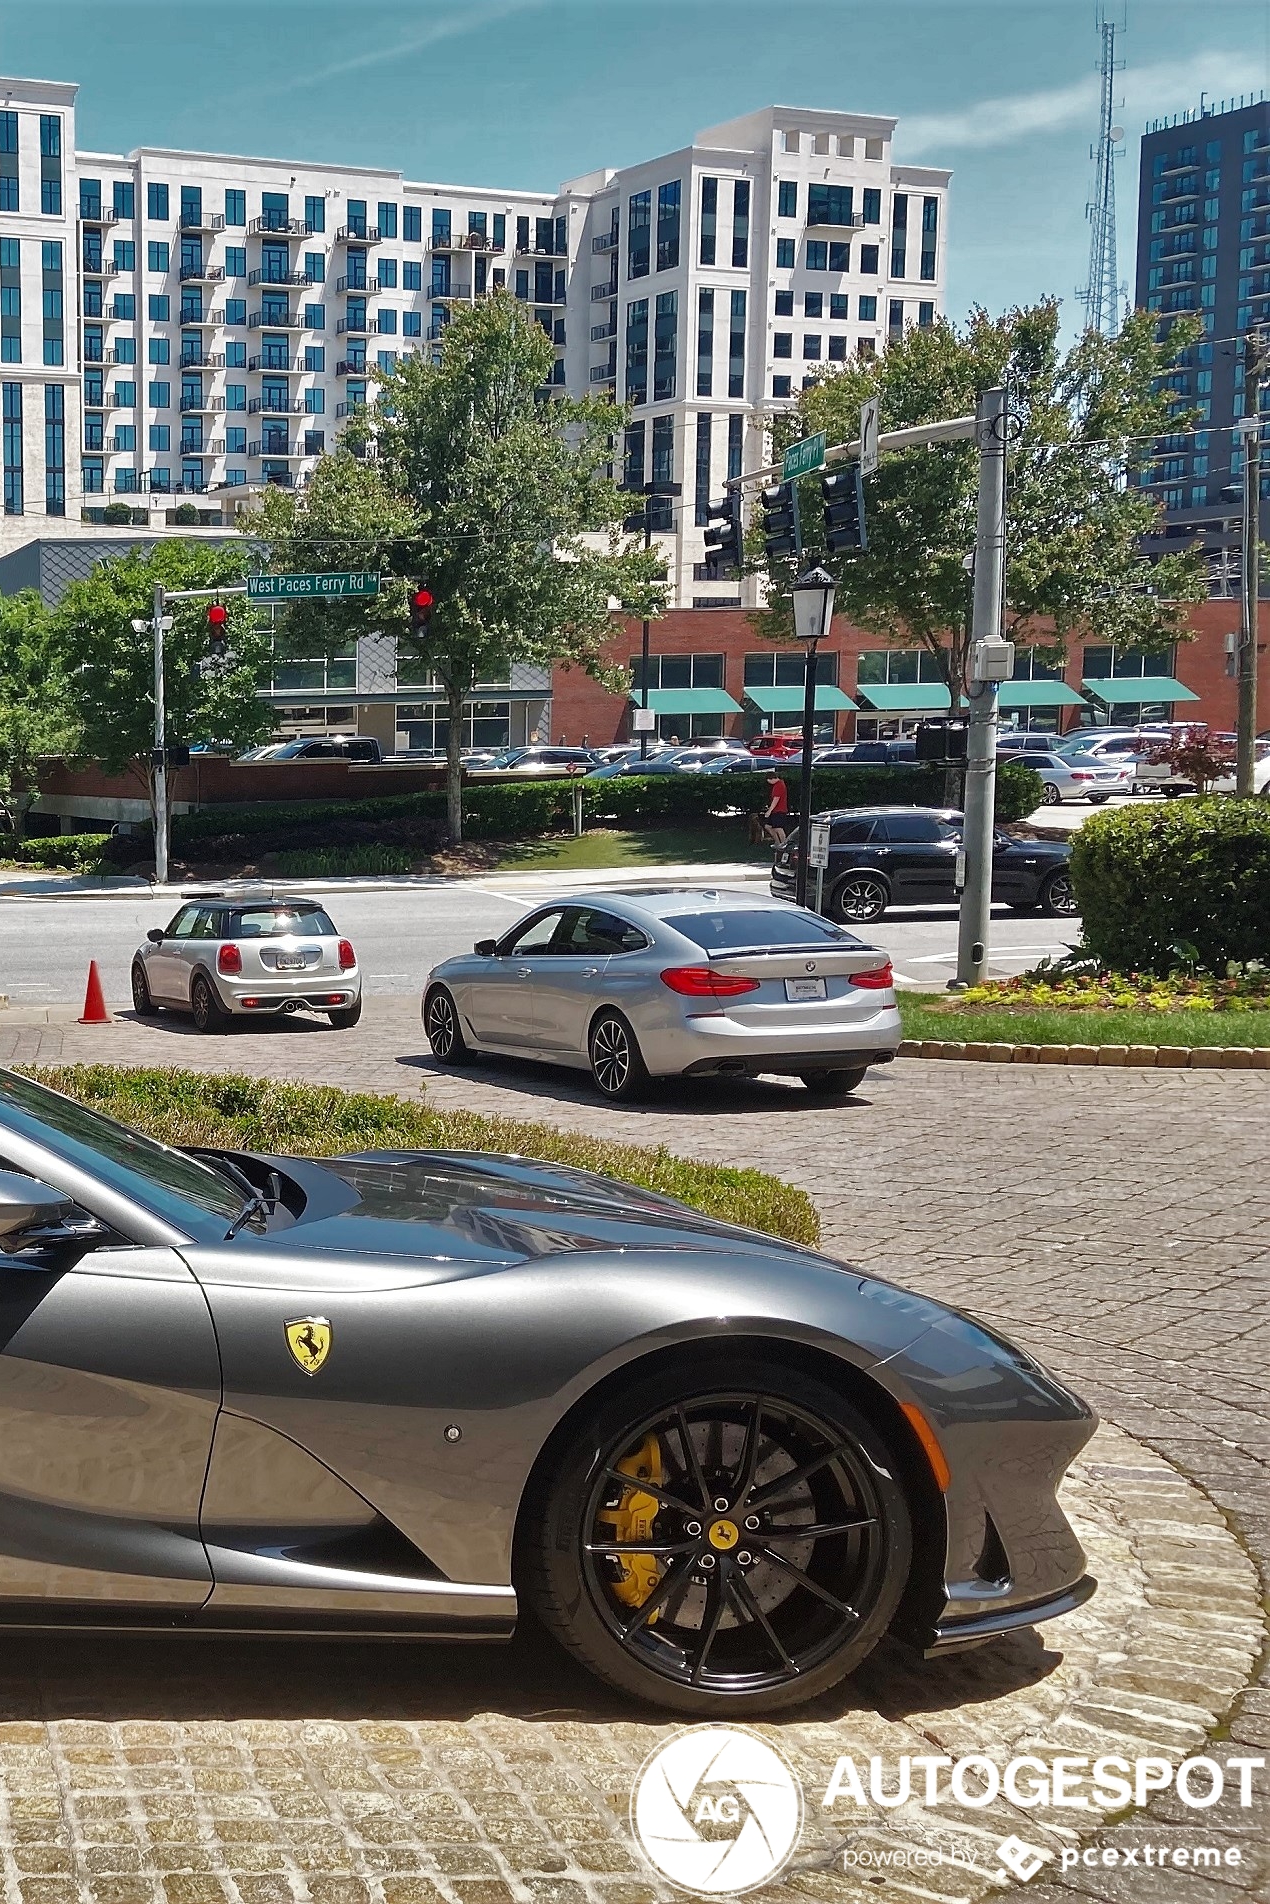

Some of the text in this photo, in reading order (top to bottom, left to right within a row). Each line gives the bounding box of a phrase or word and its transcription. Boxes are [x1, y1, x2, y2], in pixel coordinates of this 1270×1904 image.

[249, 574, 377, 593] West Paces Ferry Rd NW
